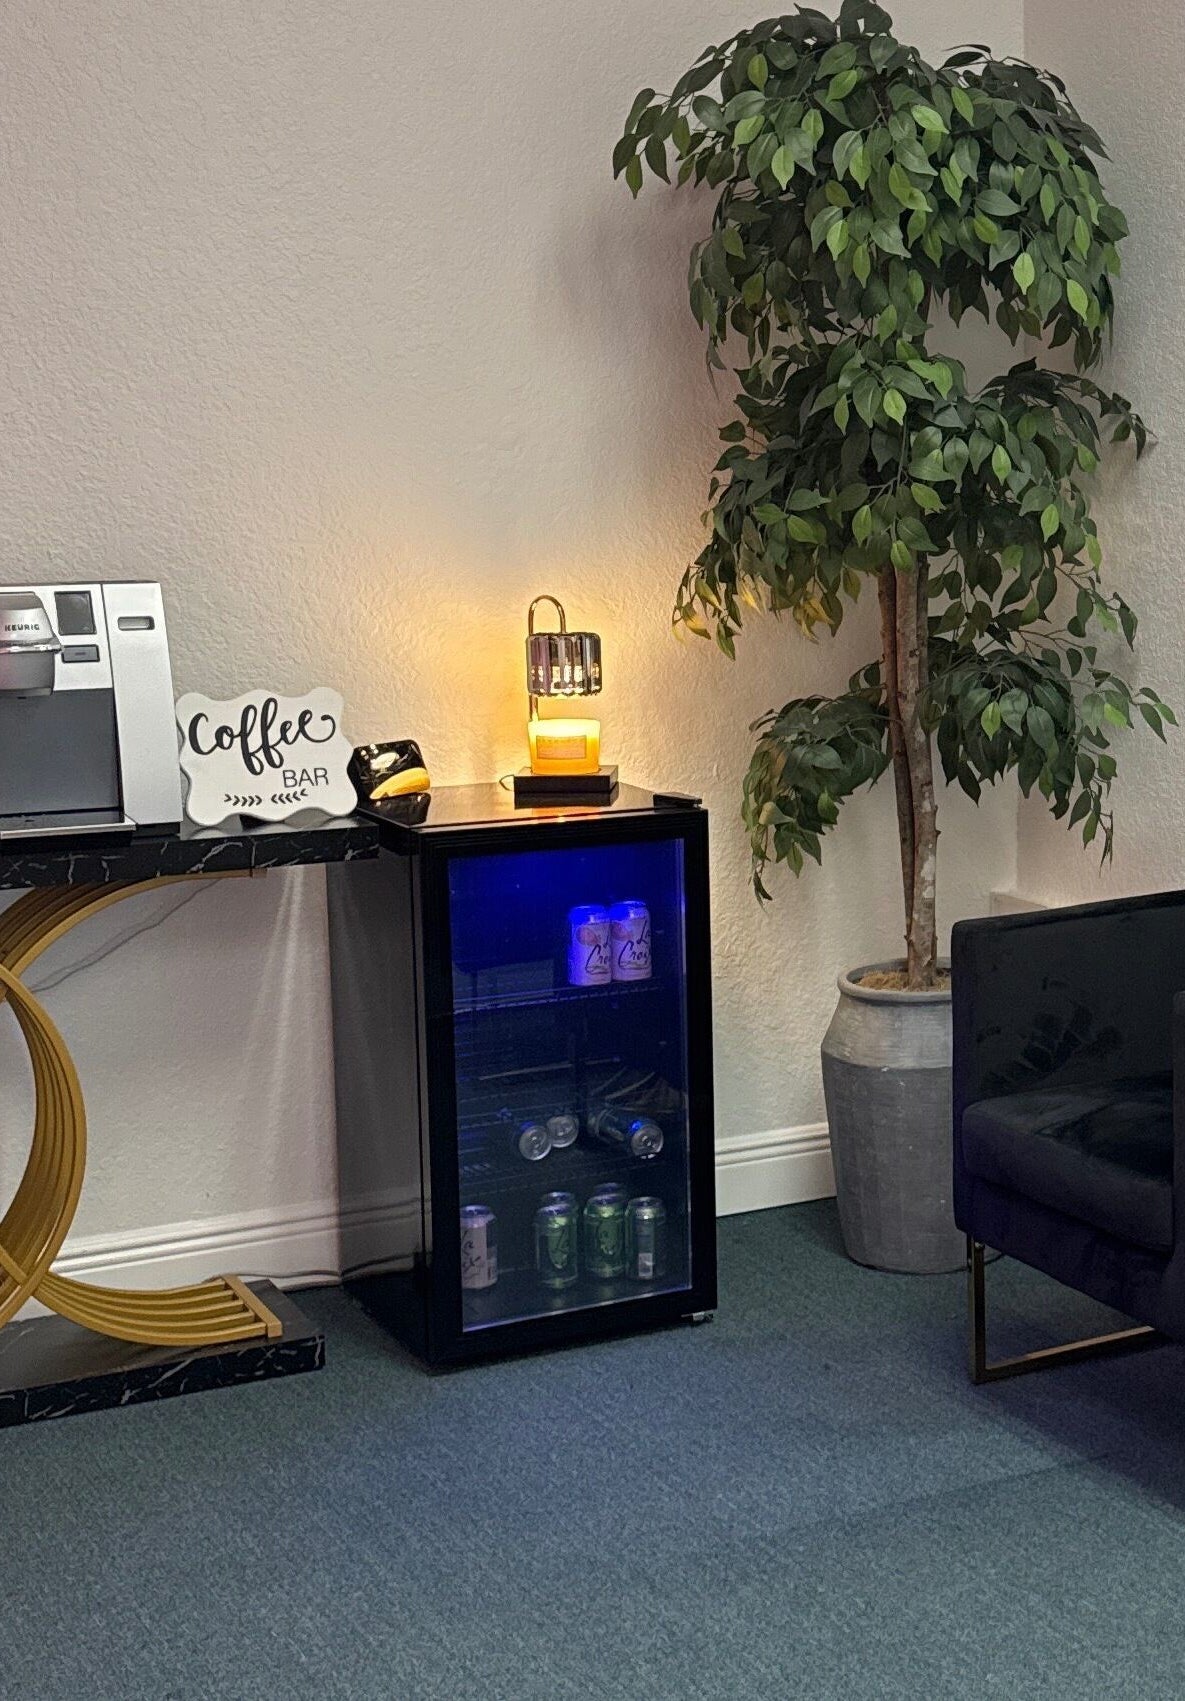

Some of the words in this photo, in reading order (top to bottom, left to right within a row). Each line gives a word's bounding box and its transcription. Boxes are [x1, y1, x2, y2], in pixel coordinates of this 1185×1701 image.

[4, 623, 40, 632] KEURIG
[188, 697, 336, 776] Coffee
[282, 767, 329, 788] BAR
